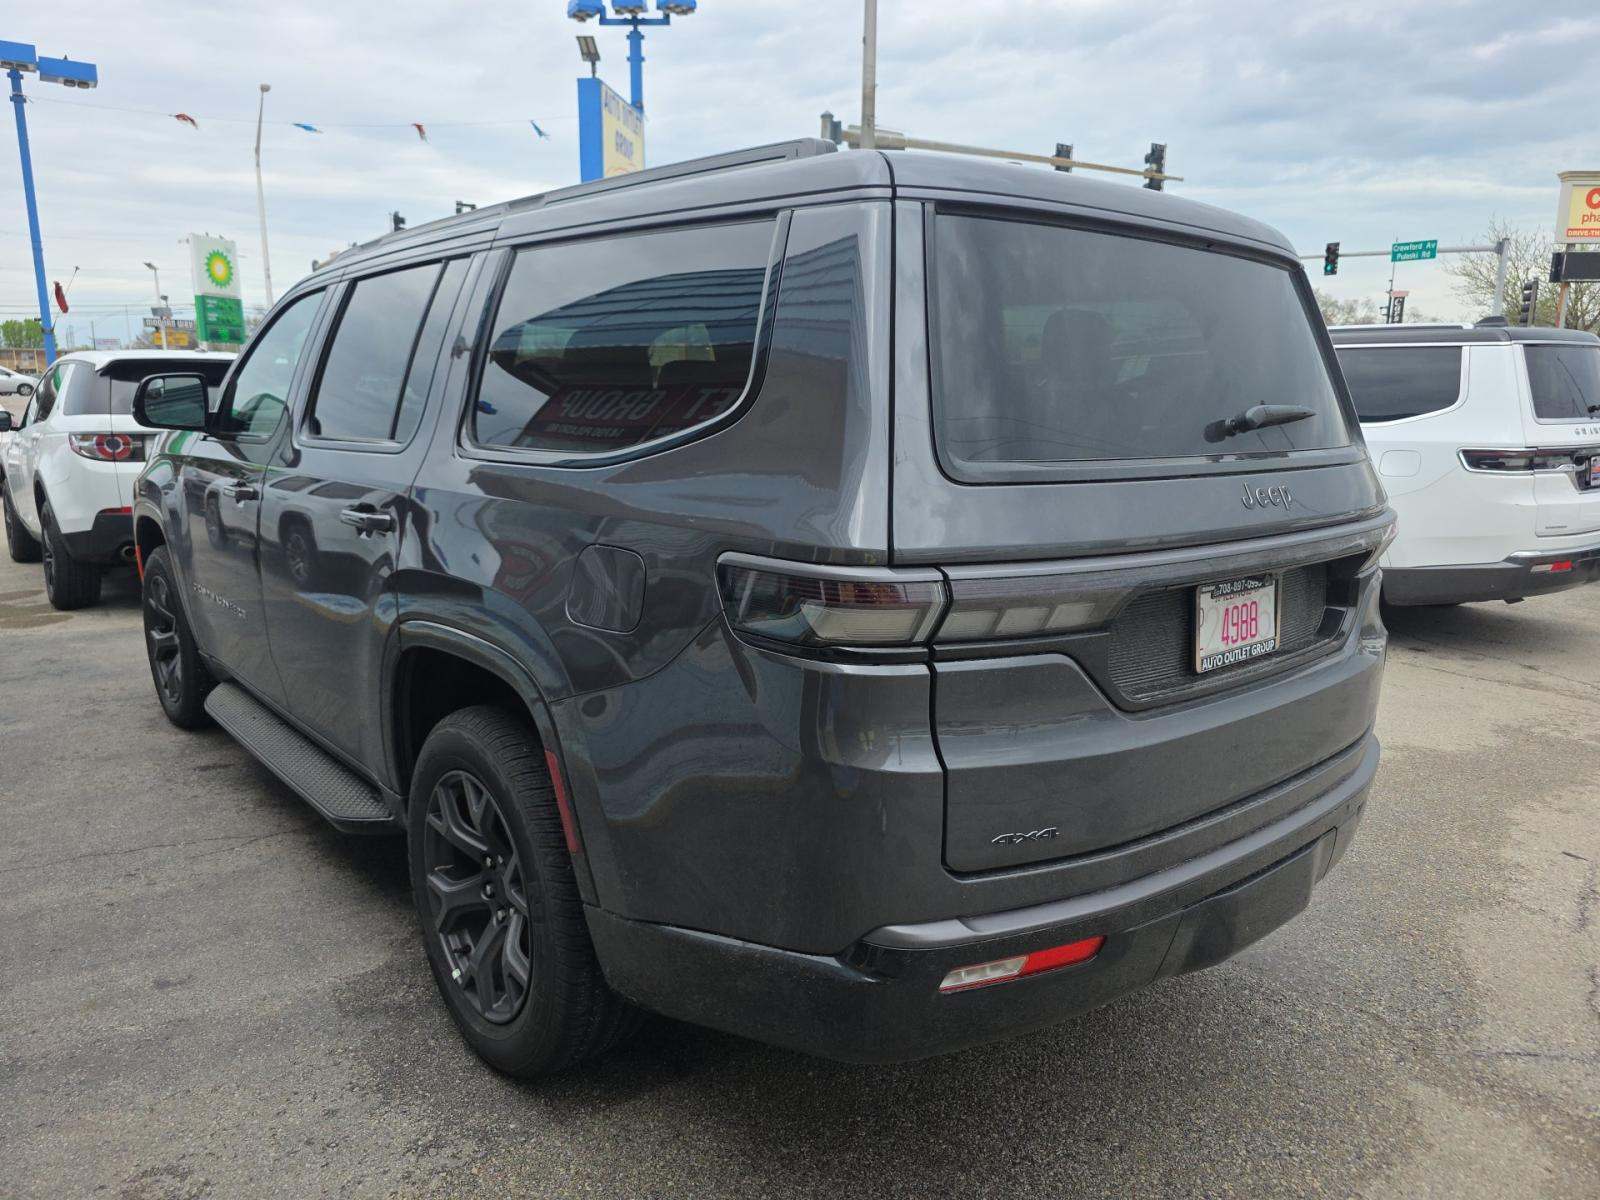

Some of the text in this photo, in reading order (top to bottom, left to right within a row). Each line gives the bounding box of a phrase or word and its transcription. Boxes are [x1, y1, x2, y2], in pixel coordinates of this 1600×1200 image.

[1393, 241, 1436, 252] Crawford Av
[1396, 251, 1419, 260] Pulaski
[1242, 482, 1292, 511] Jeep
[1221, 601, 1258, 646] 4988
[1202, 639, 1275, 671] AUTO OUTLET GROUP
